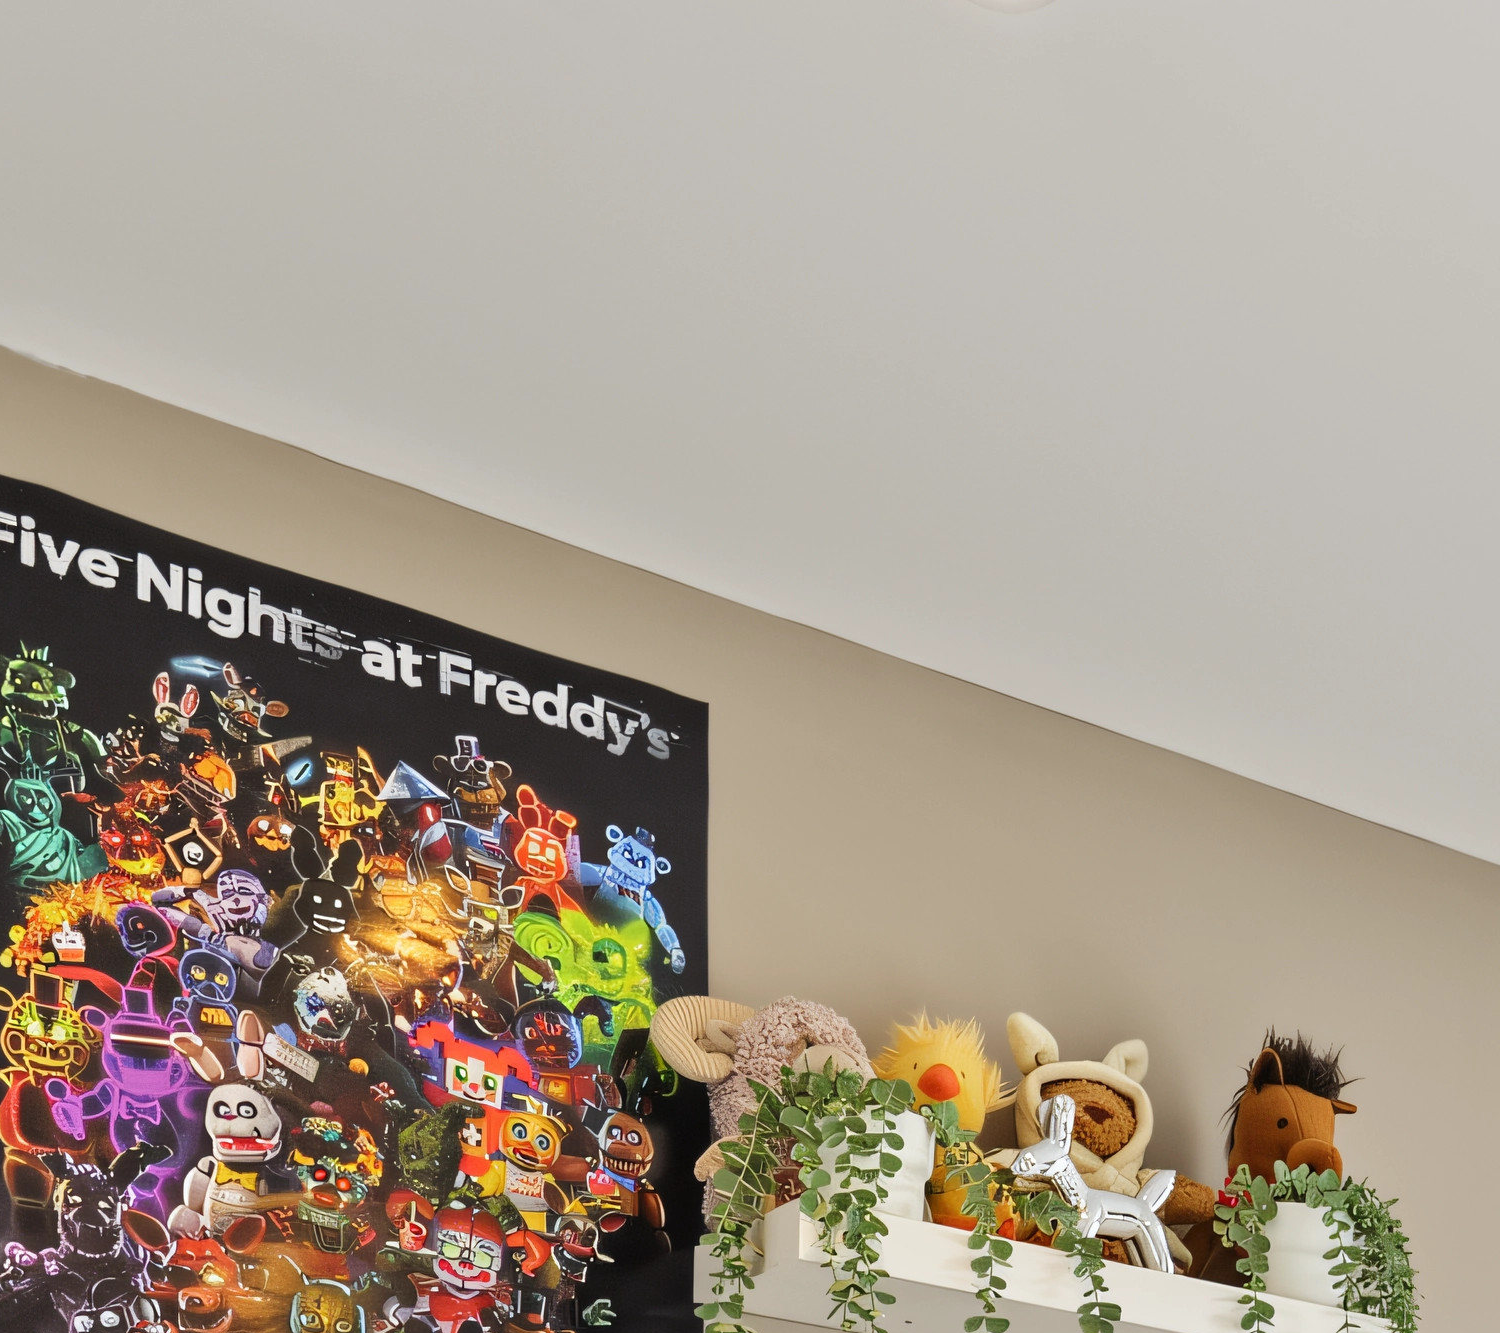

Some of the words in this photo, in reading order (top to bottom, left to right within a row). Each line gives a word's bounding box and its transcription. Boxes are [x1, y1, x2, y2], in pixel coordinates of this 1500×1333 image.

[135, 551, 345, 662] Nights
[363, 636, 423, 689] at
[437, 649, 672, 760] Freddy's
